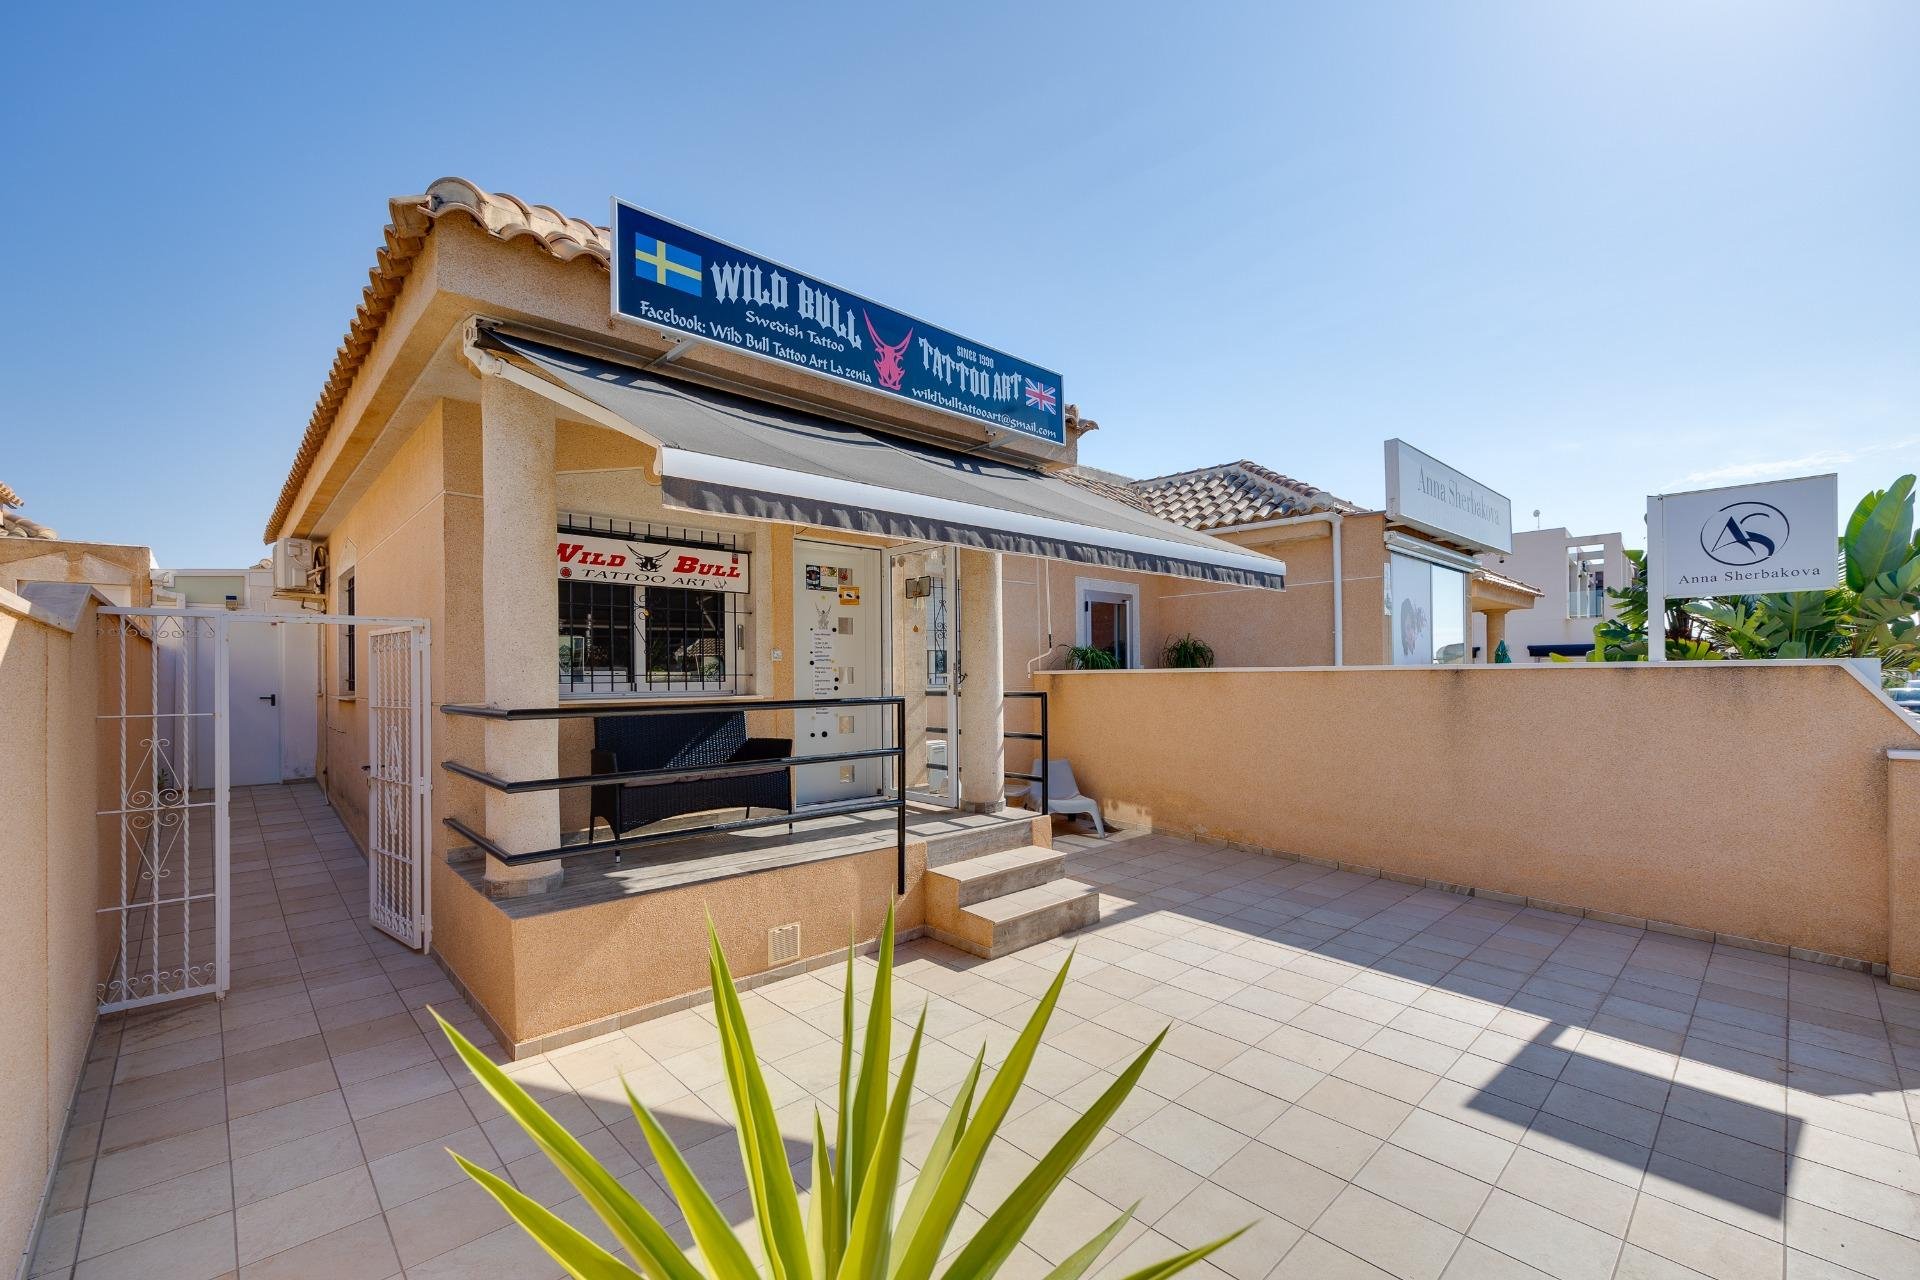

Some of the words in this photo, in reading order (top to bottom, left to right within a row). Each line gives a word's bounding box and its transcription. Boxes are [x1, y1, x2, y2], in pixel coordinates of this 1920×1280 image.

[710, 261, 789, 311] WILD
[798, 280, 862, 350] BULL
[745, 310, 803, 339] Swedish
[807, 330, 844, 352] Tattoo
[640, 300, 706, 334] Facebook:
[709, 321, 742, 344] Wild
[746, 333, 769, 352] Bull
[773, 342, 806, 363] Tattoo
[809, 353, 828, 370] Art
[830, 359, 843, 374] La
[846, 368, 872, 384] zenia
[956, 345, 977, 363] SINCE
[918, 336, 990, 400] TATTOO
[993, 371, 1022, 402] ART
[912, 387, 1057, 438] wildbulltattooart@gmail.com
[1417, 464, 1446, 502] Anna
[1448, 479, 1500, 525] Sherbakova
[582, 568, 666, 584] TATTOO
[672, 577, 710, 588] ART
[1678, 574, 1718, 585] Anna
[1724, 567, 1821, 582] Sherbakova
